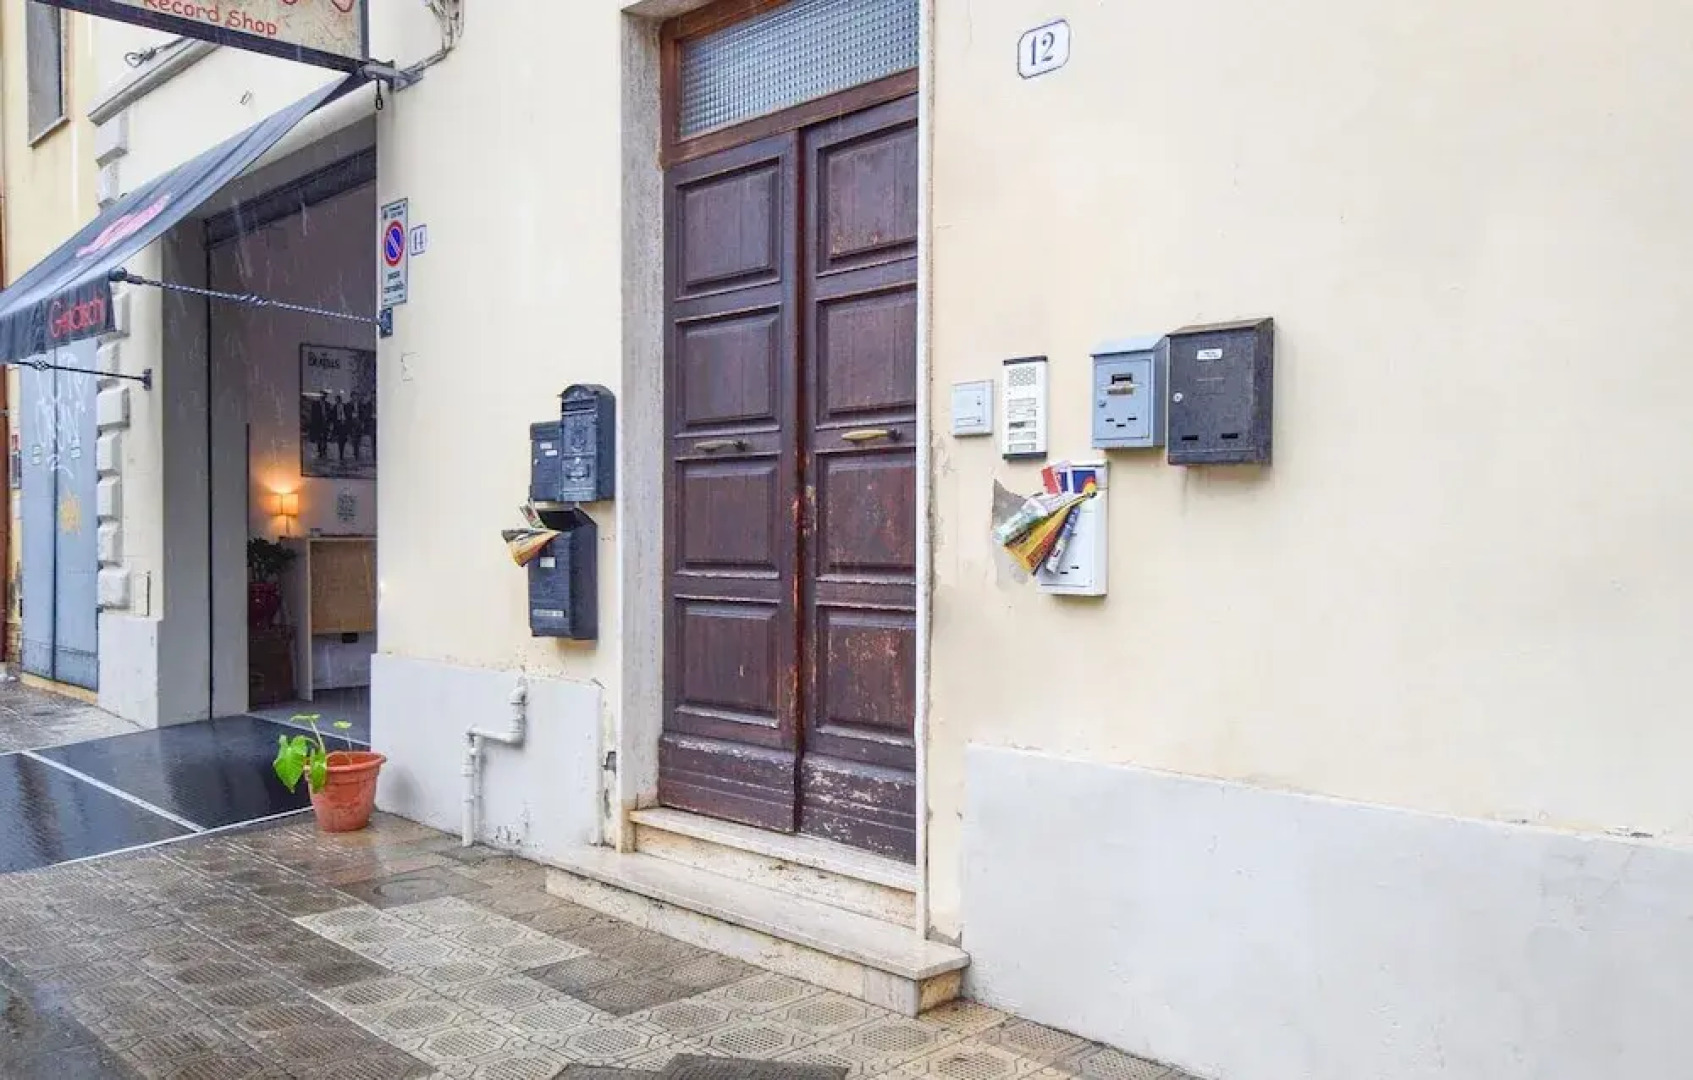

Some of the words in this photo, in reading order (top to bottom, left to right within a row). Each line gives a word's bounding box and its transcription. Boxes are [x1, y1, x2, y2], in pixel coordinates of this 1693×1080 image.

[143, 0, 219, 22] Record
[225, 10, 277, 36] Shop
[1030, 31, 1054, 66] 12
